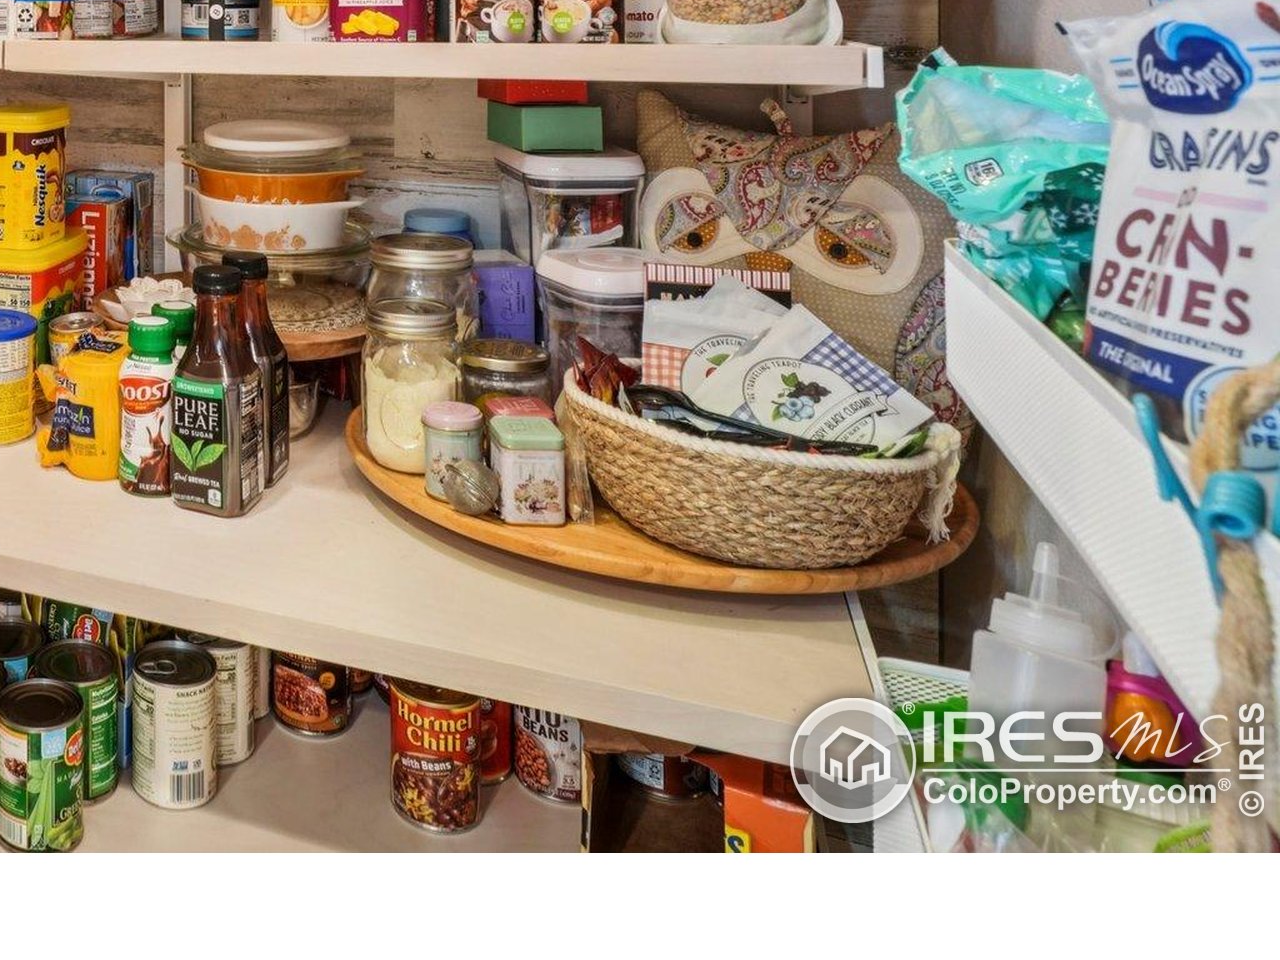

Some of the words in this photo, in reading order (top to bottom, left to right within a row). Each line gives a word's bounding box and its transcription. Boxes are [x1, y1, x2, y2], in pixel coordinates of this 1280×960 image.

[1141, 54, 1193, 96] Ocean
[1181, 52, 1242, 101] Spray
[35, 163, 47, 227] Nesquik
[81, 211, 101, 312] Luzianne
[694, 345, 707, 358] THE
[707, 338, 743, 349] TRAVELIN
[174, 397, 219, 417] PURE
[191, 430, 214, 439] SUGAR
[824, 412, 846, 431] BLACK
[397, 699, 472, 733] Hormel
[406, 726, 462, 752] Chili
[523, 716, 569, 743] BEANS
[401, 756, 420, 769] with
[421, 758, 452, 771] Beans
